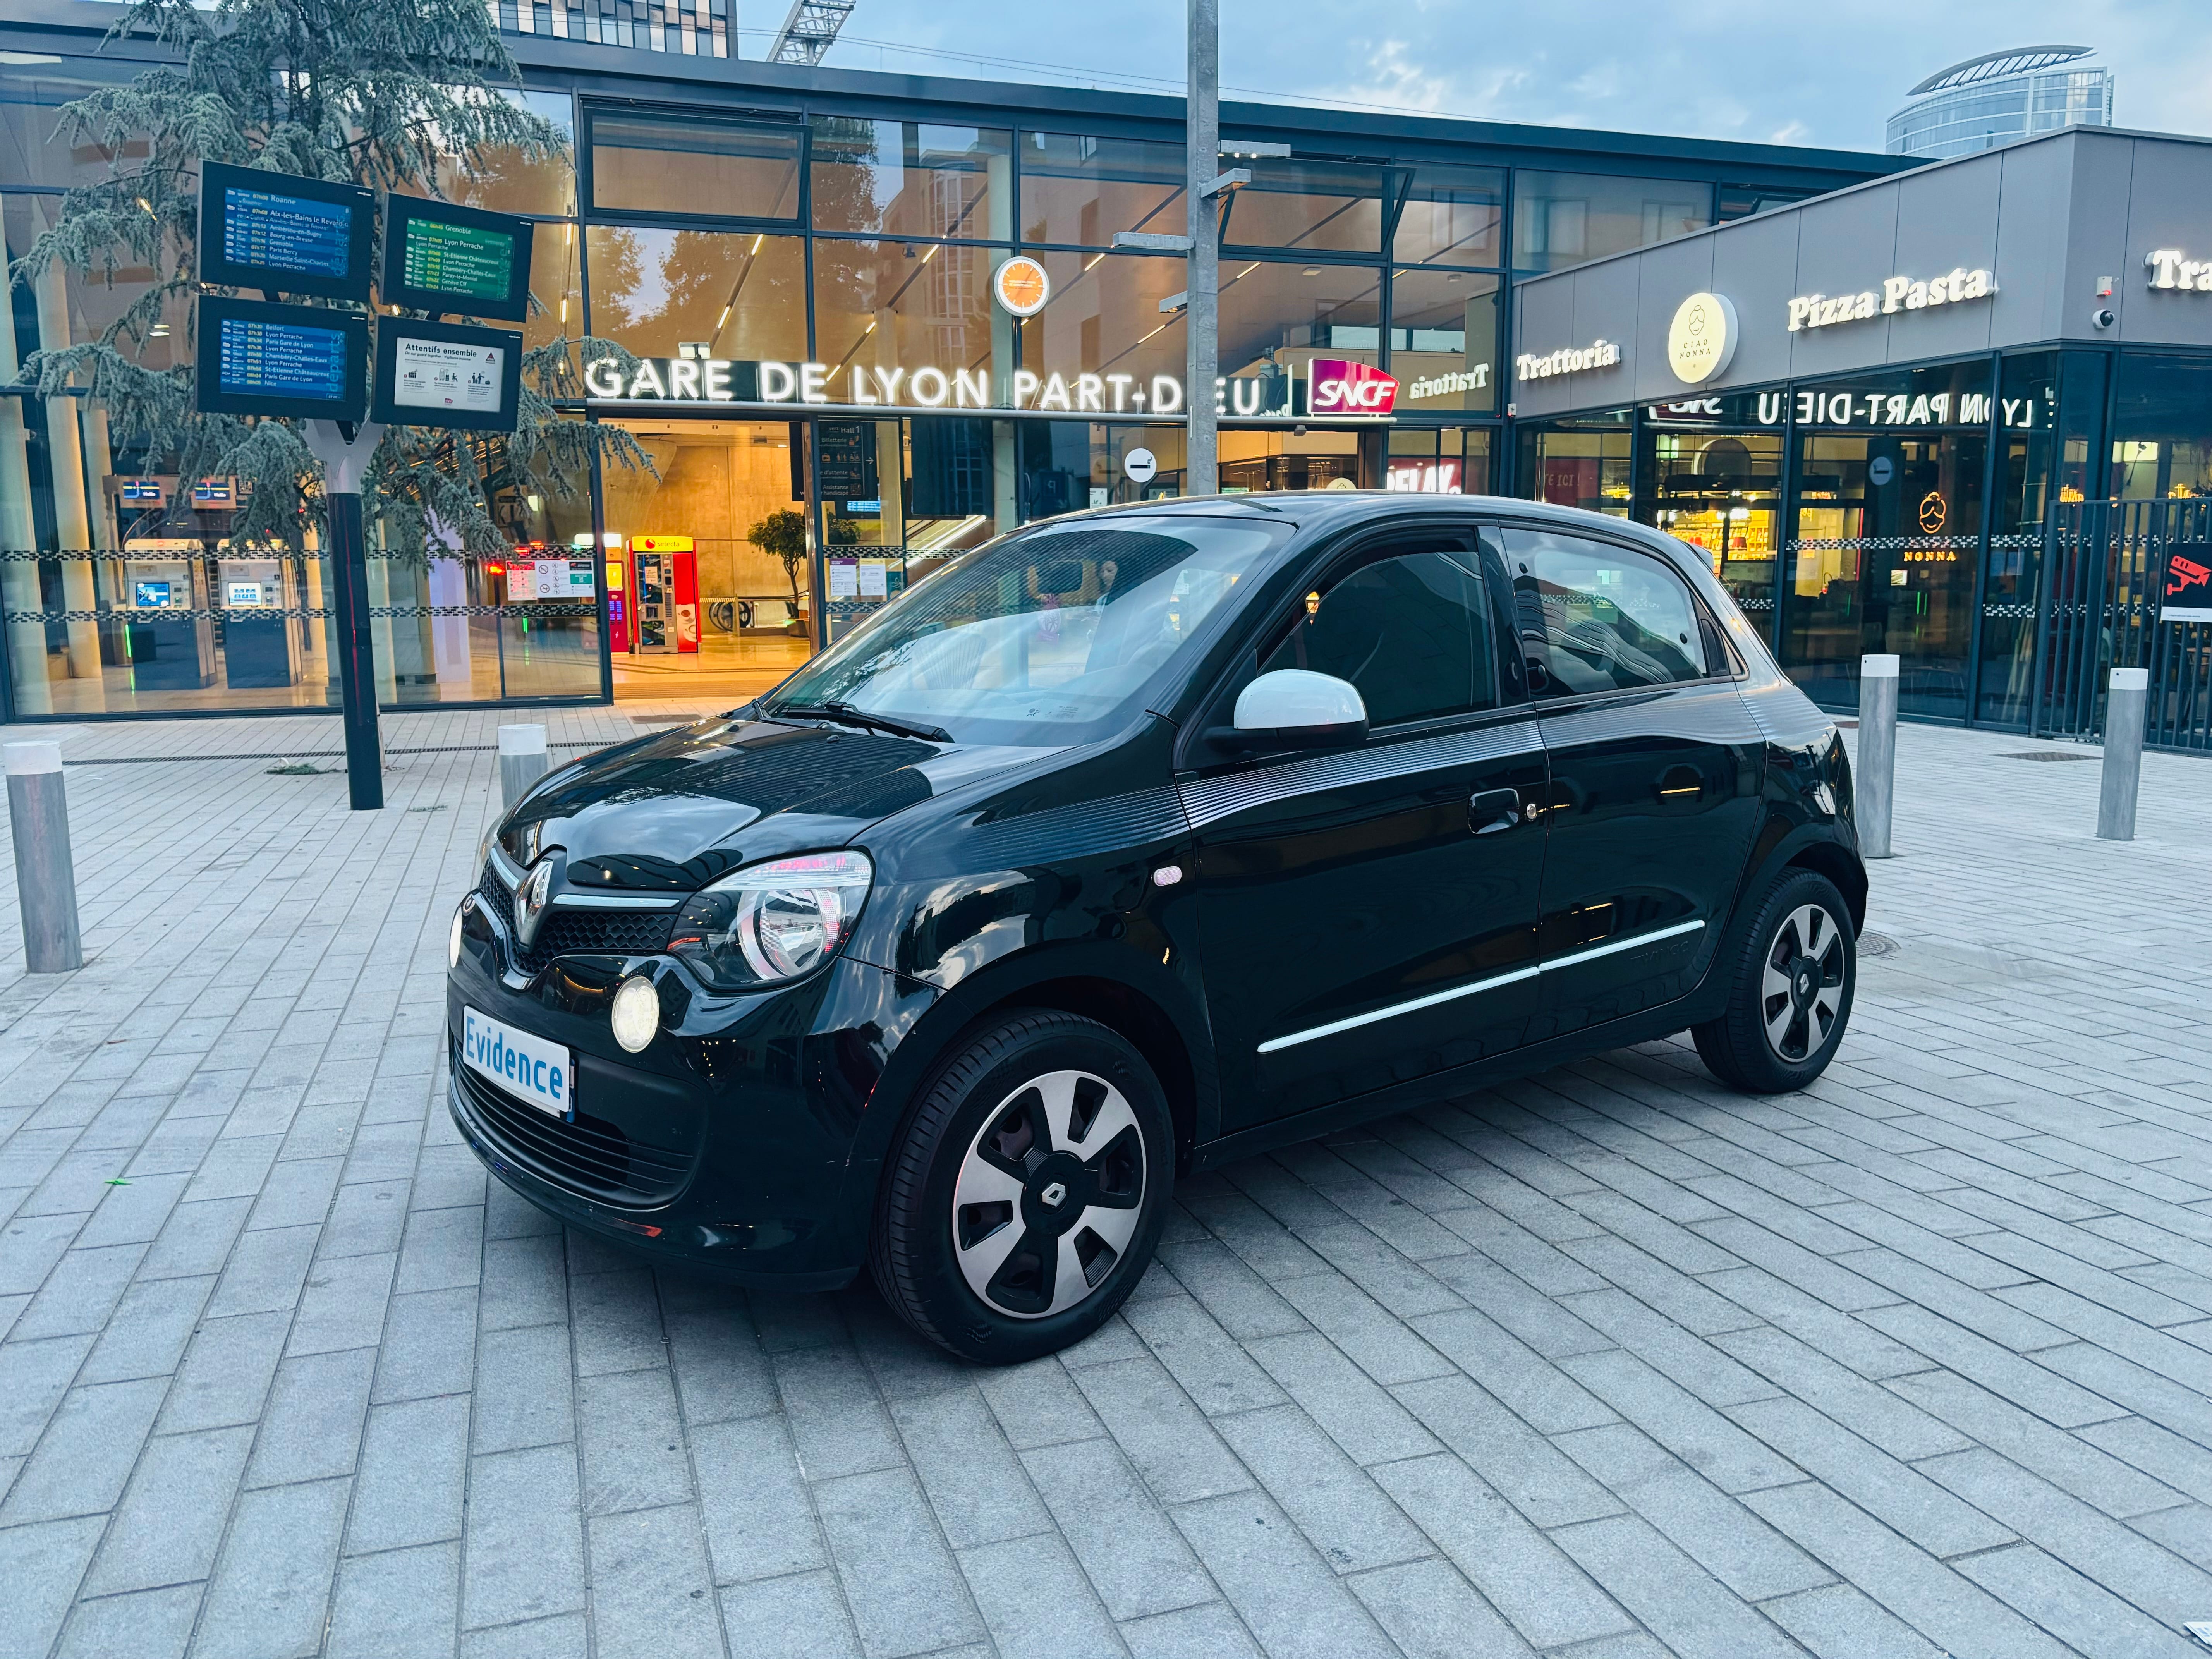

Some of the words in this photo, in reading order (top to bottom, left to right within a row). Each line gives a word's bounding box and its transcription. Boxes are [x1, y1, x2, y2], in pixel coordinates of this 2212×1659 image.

[271, 194, 296, 205] Roanne
[270, 210, 312, 222] Aix-les-Bains
[321, 218, 343, 226] Revard
[445, 225, 471, 235] Grenoble
[270, 232, 313, 243] Bourg-en-Bresse
[270, 239, 293, 247] Grenoble
[460, 240, 484, 250] Perrache
[283, 248, 298, 256] Bercy
[294, 257, 329, 266] Saint-Charles
[1786, 293, 1879, 332] Pizza
[1882, 267, 1994, 314] Pasta
[1683, 339, 1707, 349] CIAO
[405, 343, 441, 353] Attentifs
[443, 349, 477, 357] ensemble
[1680, 348, 1710, 359] NONNA
[265, 352, 327, 363] Chambéry-Challes-Eaux
[1516, 339, 1620, 381] Trattoria
[585, 357, 732, 400] GARE
[760, 361, 827, 402] DE
[853, 365, 988, 406] LYON
[1013, 371, 1261, 414] PART-DU
[1314, 379, 1396, 408] SNCF
[1903, 551, 1956, 562] NONNA
[466, 1015, 563, 1100] Evidence
